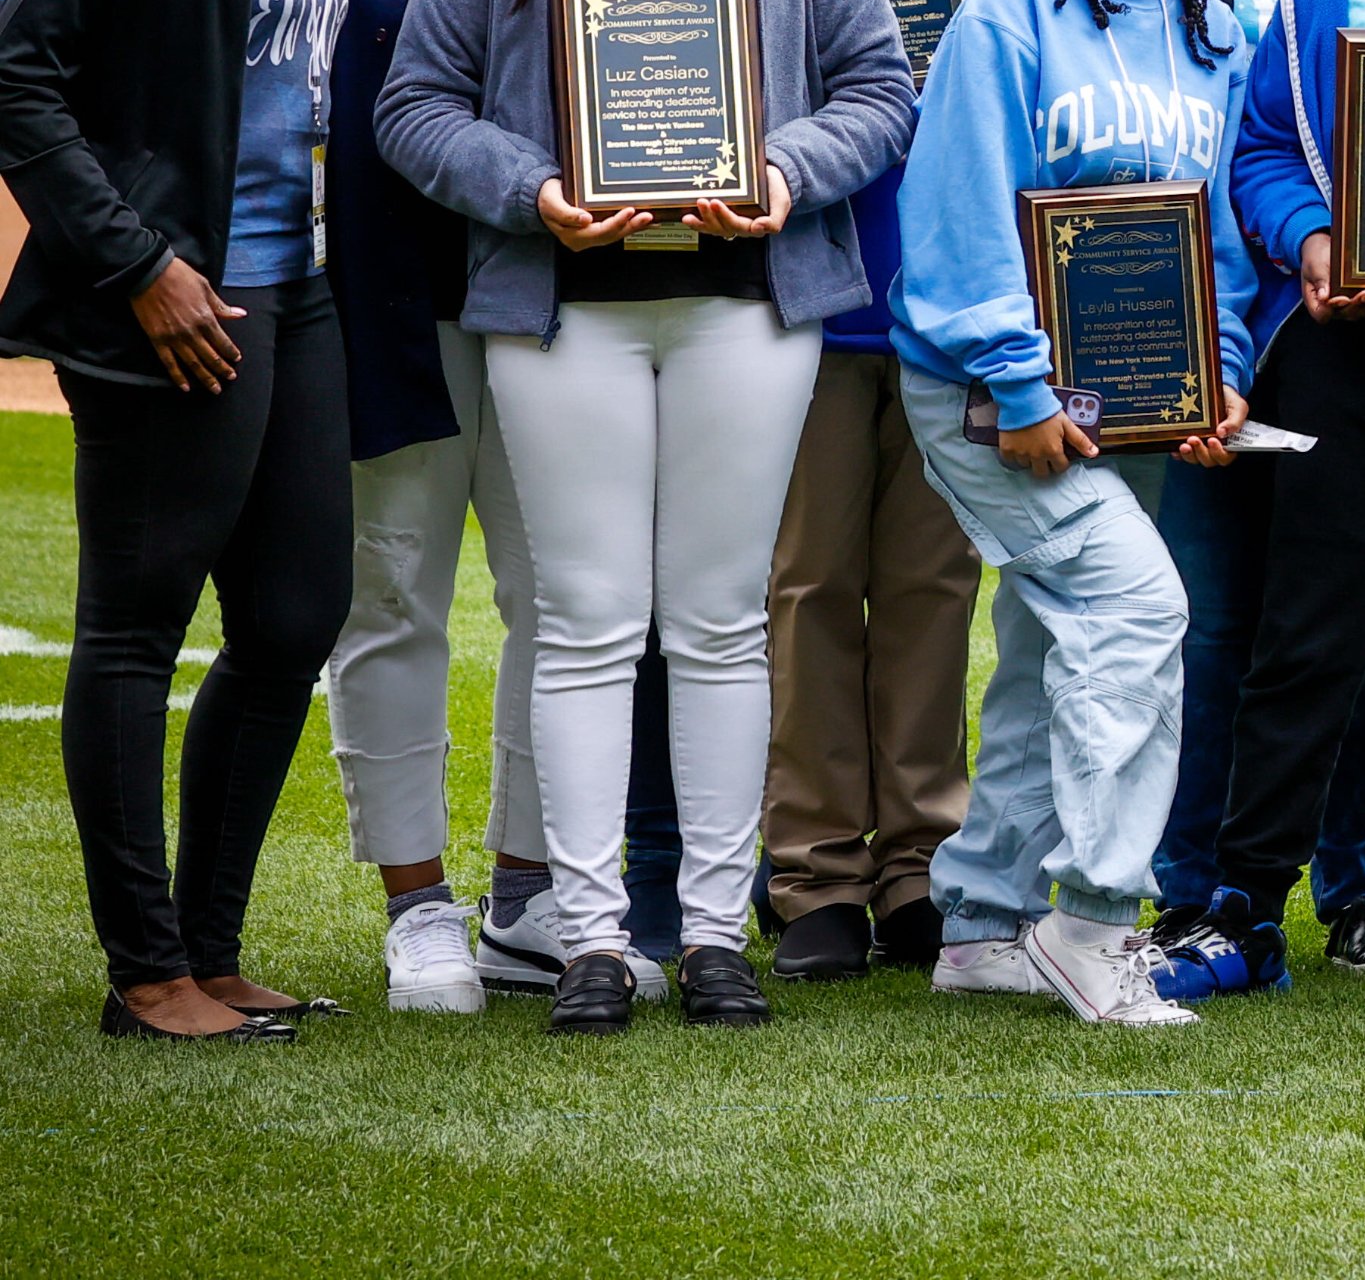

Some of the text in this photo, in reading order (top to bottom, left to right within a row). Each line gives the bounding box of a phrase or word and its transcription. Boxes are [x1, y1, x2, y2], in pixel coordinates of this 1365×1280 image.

[600, 17, 715, 29] COMMUNITY SERVICE AWARD
[605, 64, 709, 82] Luz Casiano
[610, 85, 711, 98] In recognition of your
[606, 95, 716, 109] outstanding dedicated
[602, 110, 636, 120] service
[637, 109, 649, 119] to
[649, 110, 666, 118] our
[1036, 80, 1225, 178] OLUMB
[1072, 246, 1179, 259] COMMUNITY SERVICE AWARD
[1078, 299, 1174, 316] Layla Hussein
